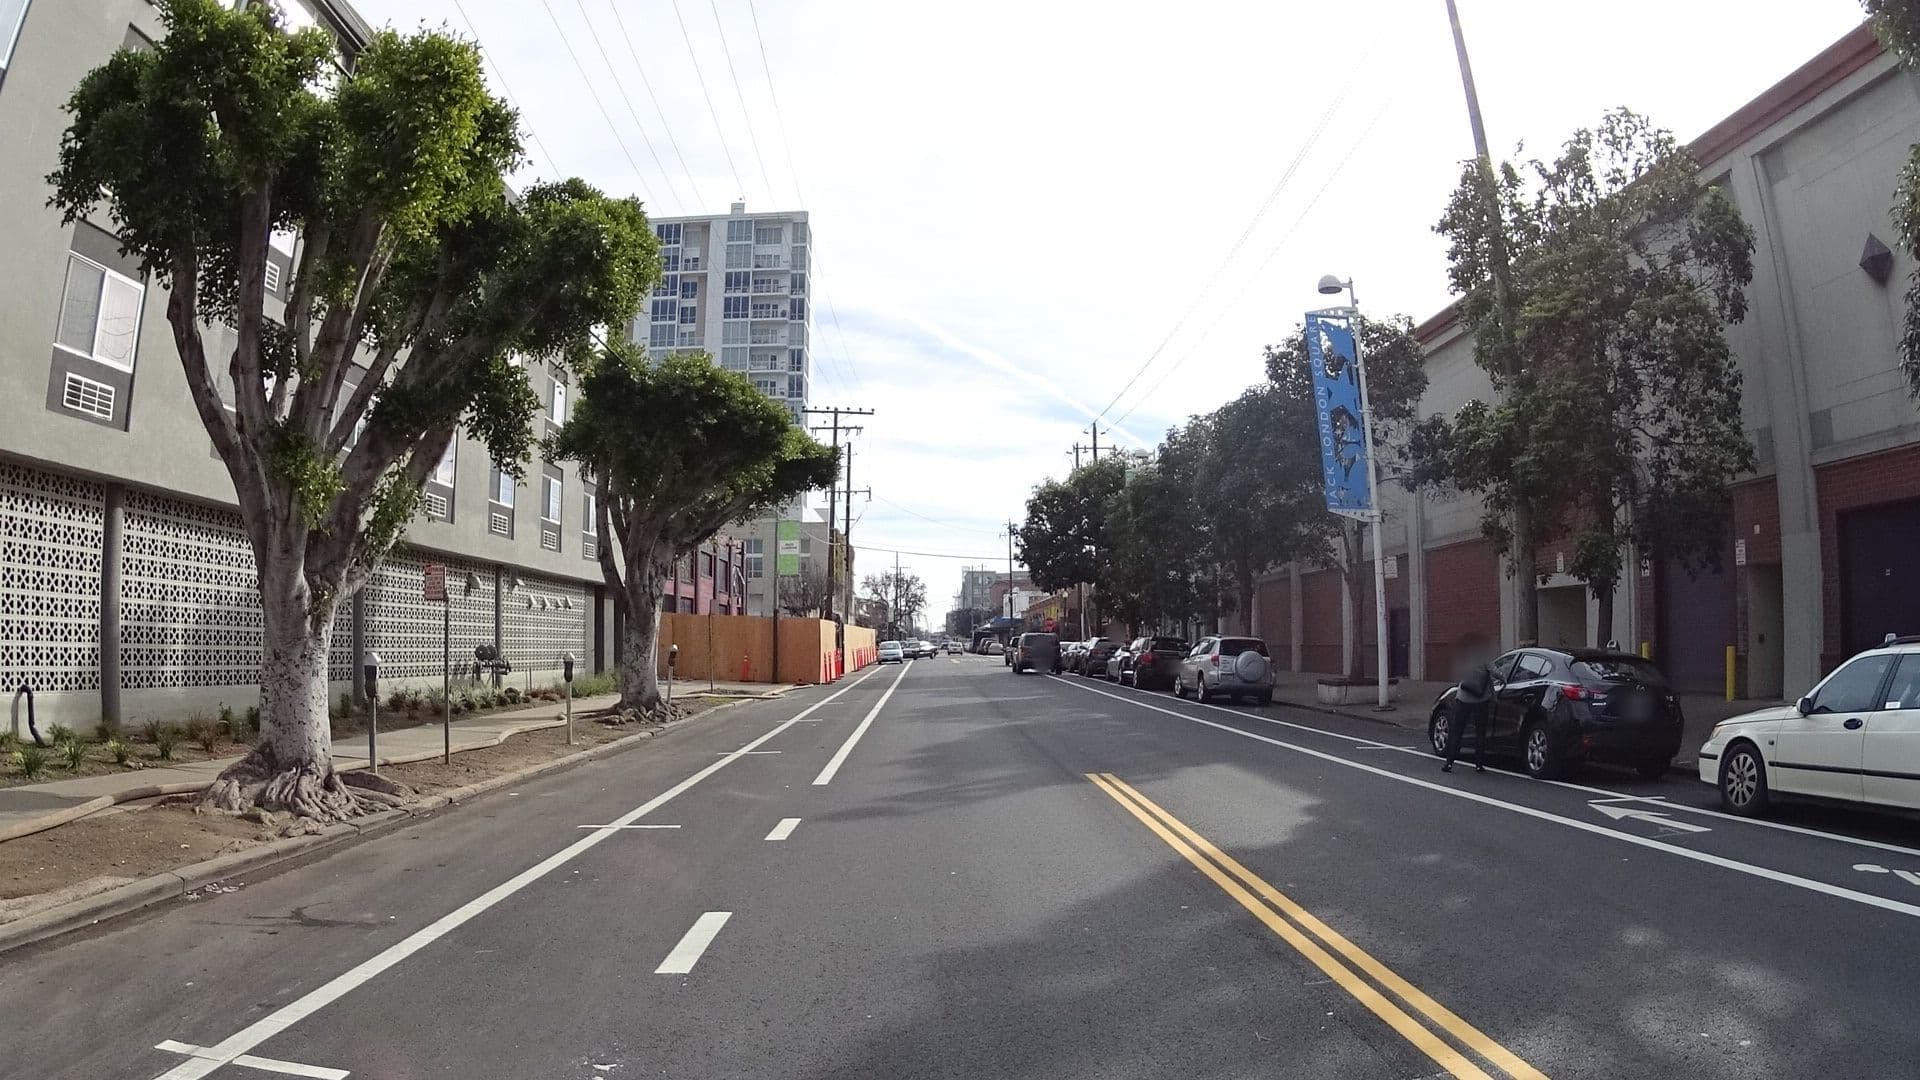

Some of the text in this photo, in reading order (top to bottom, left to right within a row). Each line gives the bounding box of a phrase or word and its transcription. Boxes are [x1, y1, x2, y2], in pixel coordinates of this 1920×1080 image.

[1308, 314, 1339, 505] JACK LONDON SQUARE
